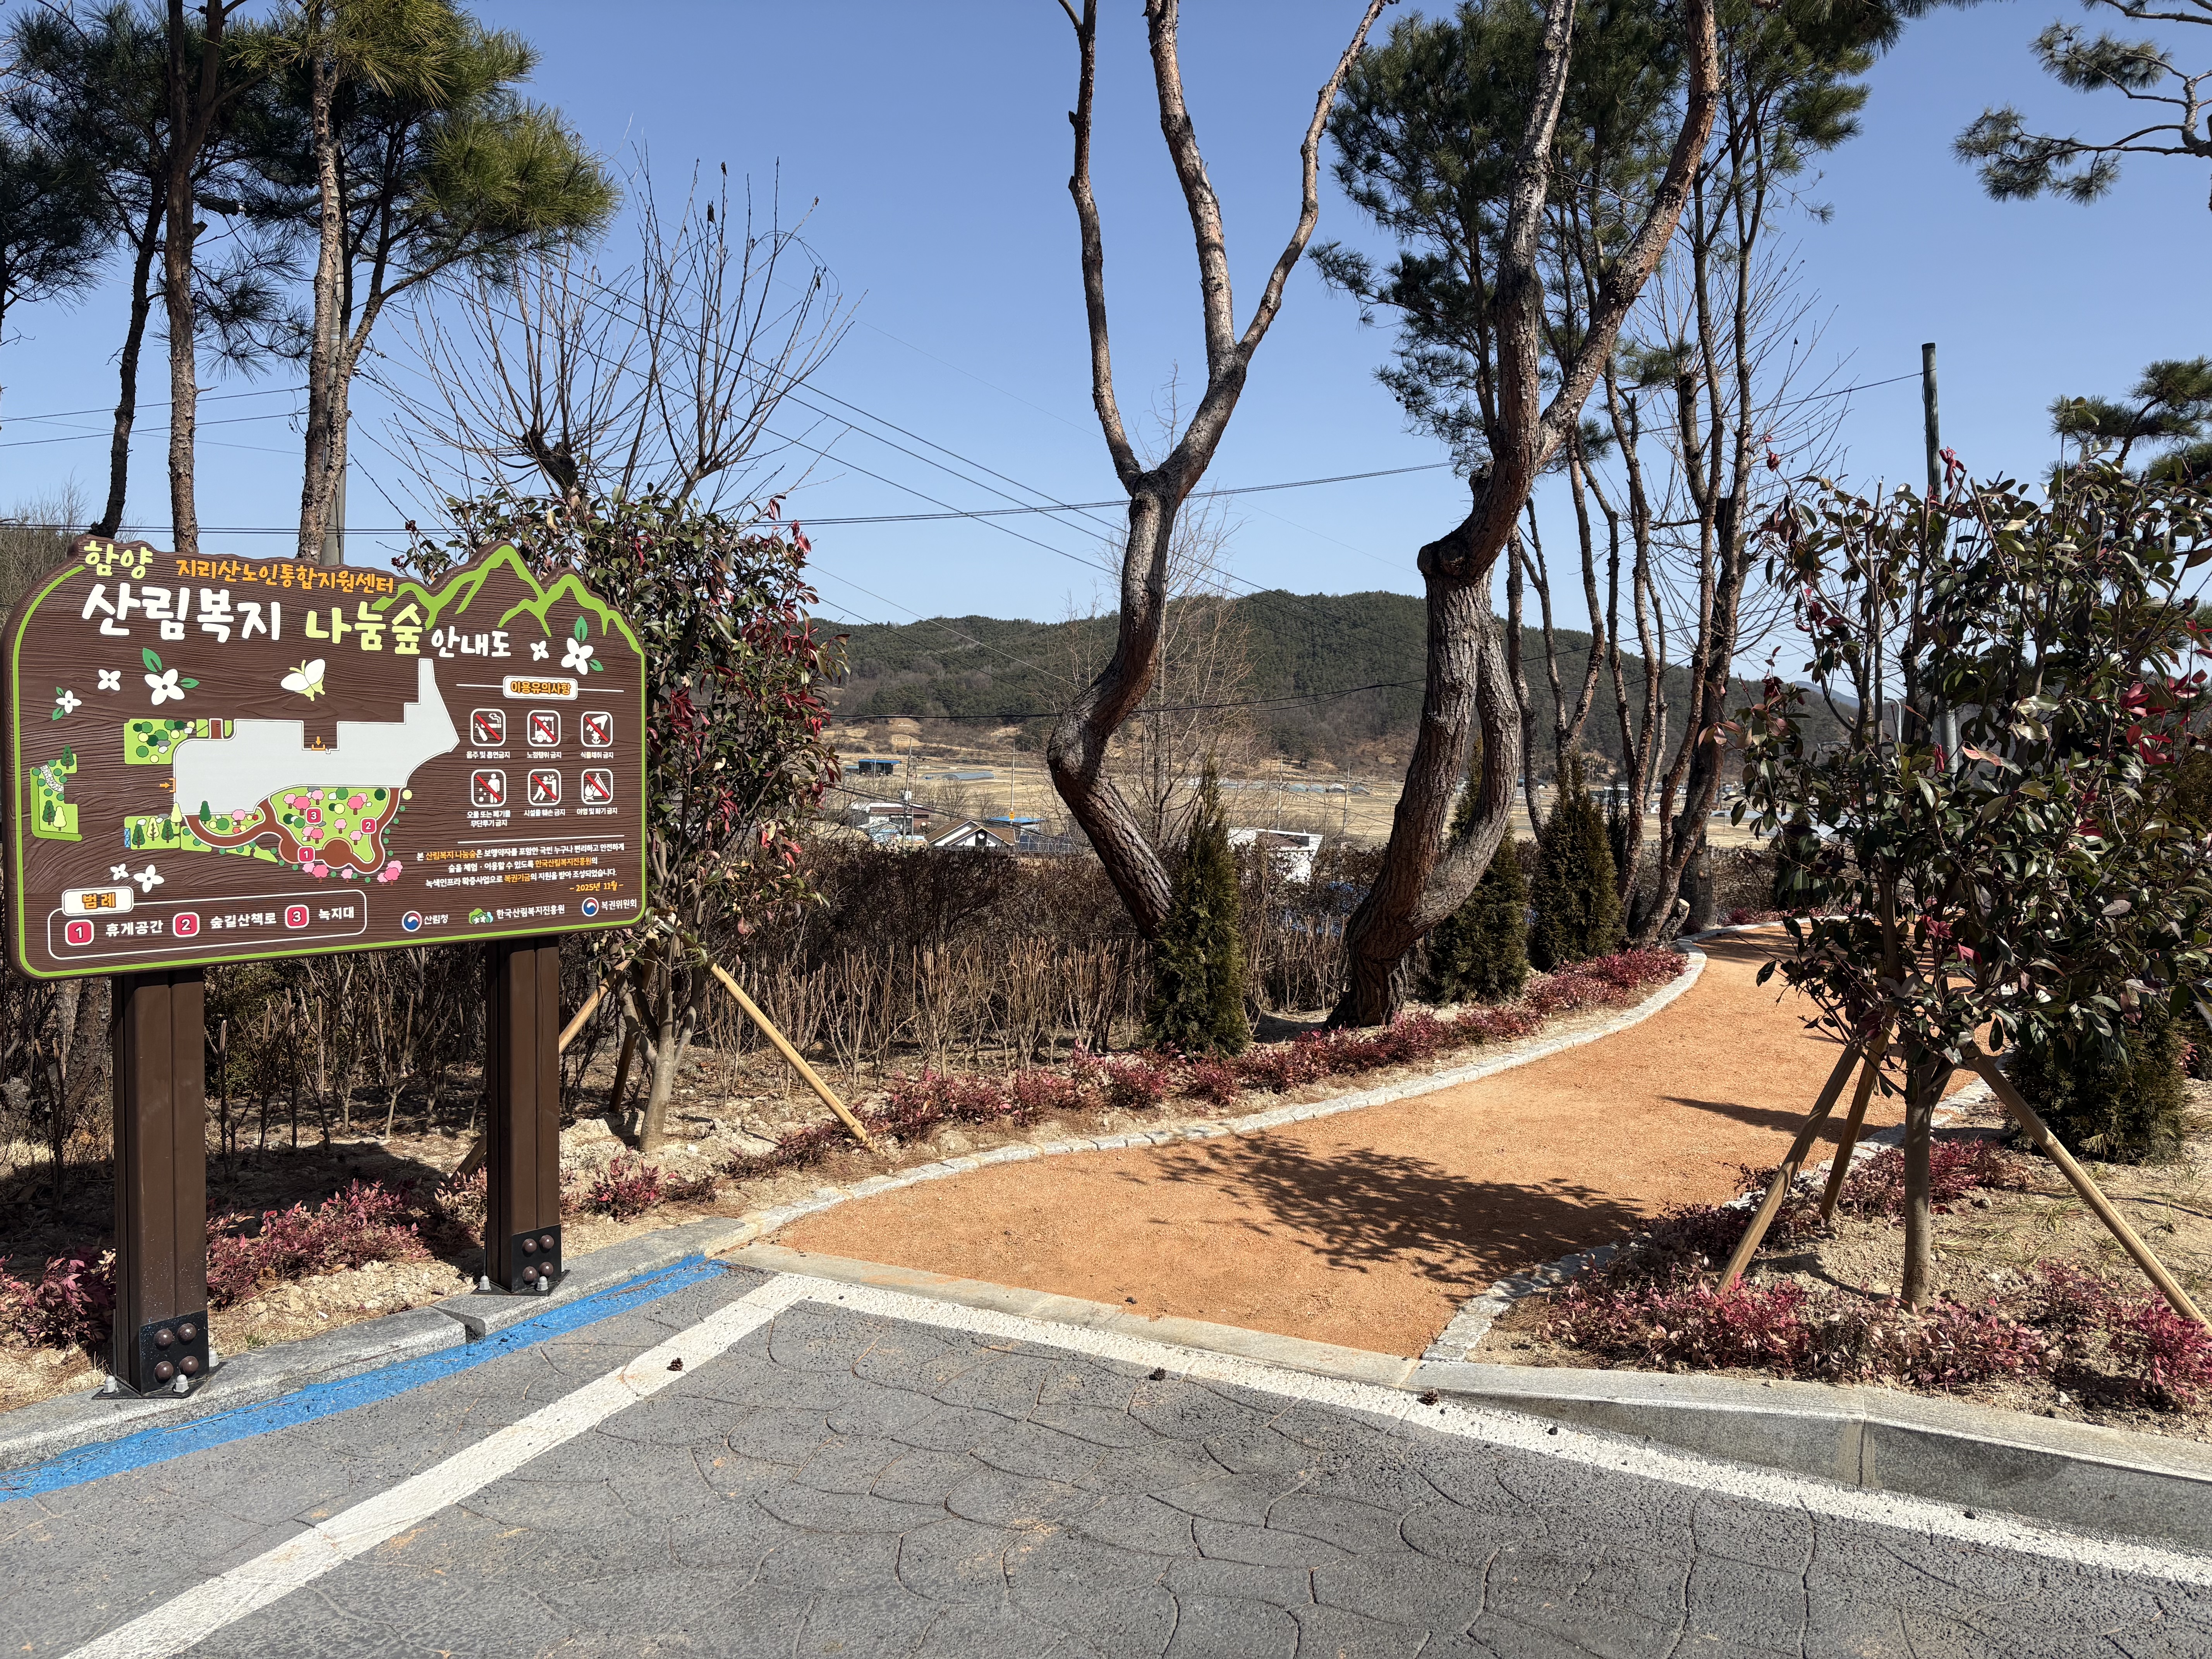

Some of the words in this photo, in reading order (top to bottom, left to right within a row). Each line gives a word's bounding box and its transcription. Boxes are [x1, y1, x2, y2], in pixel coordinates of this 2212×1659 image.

[84, 540, 153, 579] 함양
[176, 560, 394, 594] 지리산노인통합지원센터
[81, 582, 281, 643] 산림복지
[305, 601, 423, 655] 나눔숲
[431, 626, 512, 658] 안내도
[510, 680, 572, 695] 이용유의사항
[466, 751, 479, 759] 음주
[311, 811, 317, 820] 3
[467, 811, 479, 819] 오물
[471, 819, 495, 828] 무단투기
[303, 850, 309, 859] 1
[416, 852, 424, 861] 본
[426, 850, 454, 860] 산림복지
[455, 849, 483, 859] 나눔숲은
[484, 848, 518, 857] 보행약자를
[519, 847, 539, 855] 포함한
[539, 846, 553, 855] 국민
[554, 845, 573, 855] 누구나
[574, 844, 599, 853] 편리하고
[600, 843, 625, 852] 안전하게
[484, 861, 505, 871] 이용할
[505, 861, 513, 870] 수
[514, 860, 534, 869] 있도록
[535, 856, 598, 868] 한국산림복지진흥원의
[425, 877, 461, 888] 녹색인프라
[462, 875, 503, 886] 확충사업으로
[504, 872, 537, 883] 복권기금의
[538, 872, 558, 881] 지원을
[558, 871, 572, 880] 받아
[573, 867, 617, 879] 조성되었습니다.
[576, 882, 601, 892] 2025년
[603, 880, 618, 891] 11월
[496, 904, 565, 919] 한국산림복지진흥원
[601, 898, 637, 910] 복권위원회
[180, 919, 191, 931] 2
[210, 912, 277, 929] 숲길산책로
[292, 910, 302, 922] 3
[318, 906, 354, 920] 녹지대
[424, 914, 448, 925] 산림청
[75, 926, 83, 939] 1
[105, 920, 164, 937] 휴게공간
